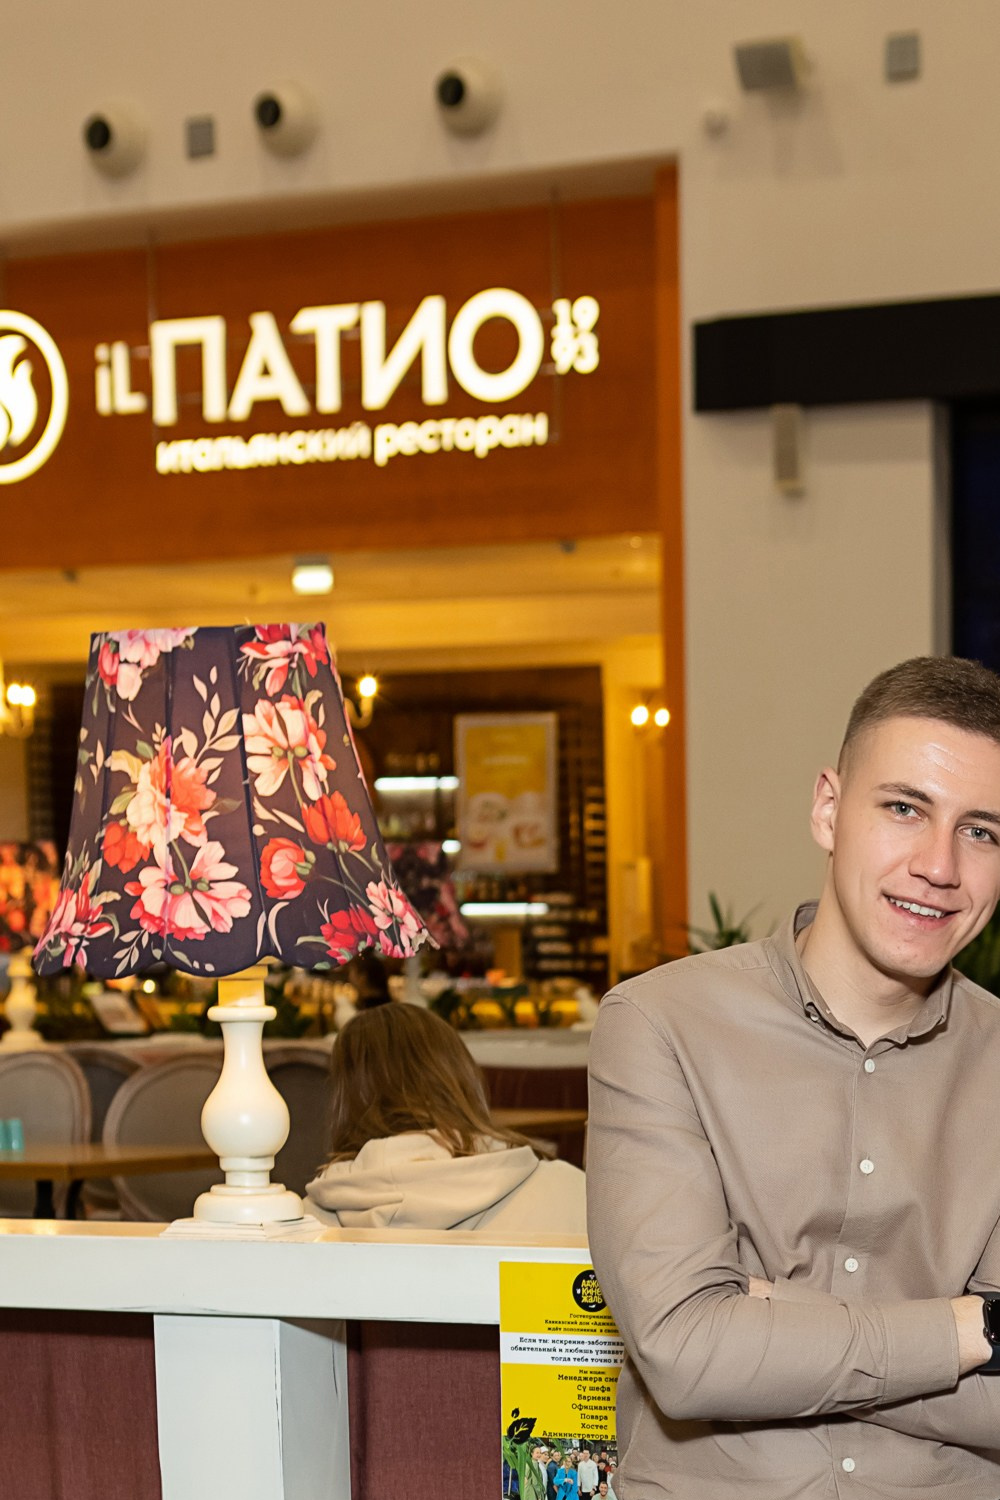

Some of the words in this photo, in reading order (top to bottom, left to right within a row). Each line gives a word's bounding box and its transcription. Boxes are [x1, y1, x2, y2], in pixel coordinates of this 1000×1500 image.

[151, 287, 545, 426] ПАТИО
[156, 420, 372, 474] итальянский
[373, 413, 549, 467] ресторан
[510, 1344, 556, 1352] обаятельный
[595, 1348, 624, 1356] узнават
[557, 1374, 603, 1383] Менеджера
[577, 1384, 587, 1392] Су
[588, 1385, 611, 1393] шефа
[577, 1394, 611, 1402] Бармена
[580, 1413, 609, 1421] Повара
[580, 1423, 609, 1431] Хостес
[542, 1430, 609, 1440] Администратора
